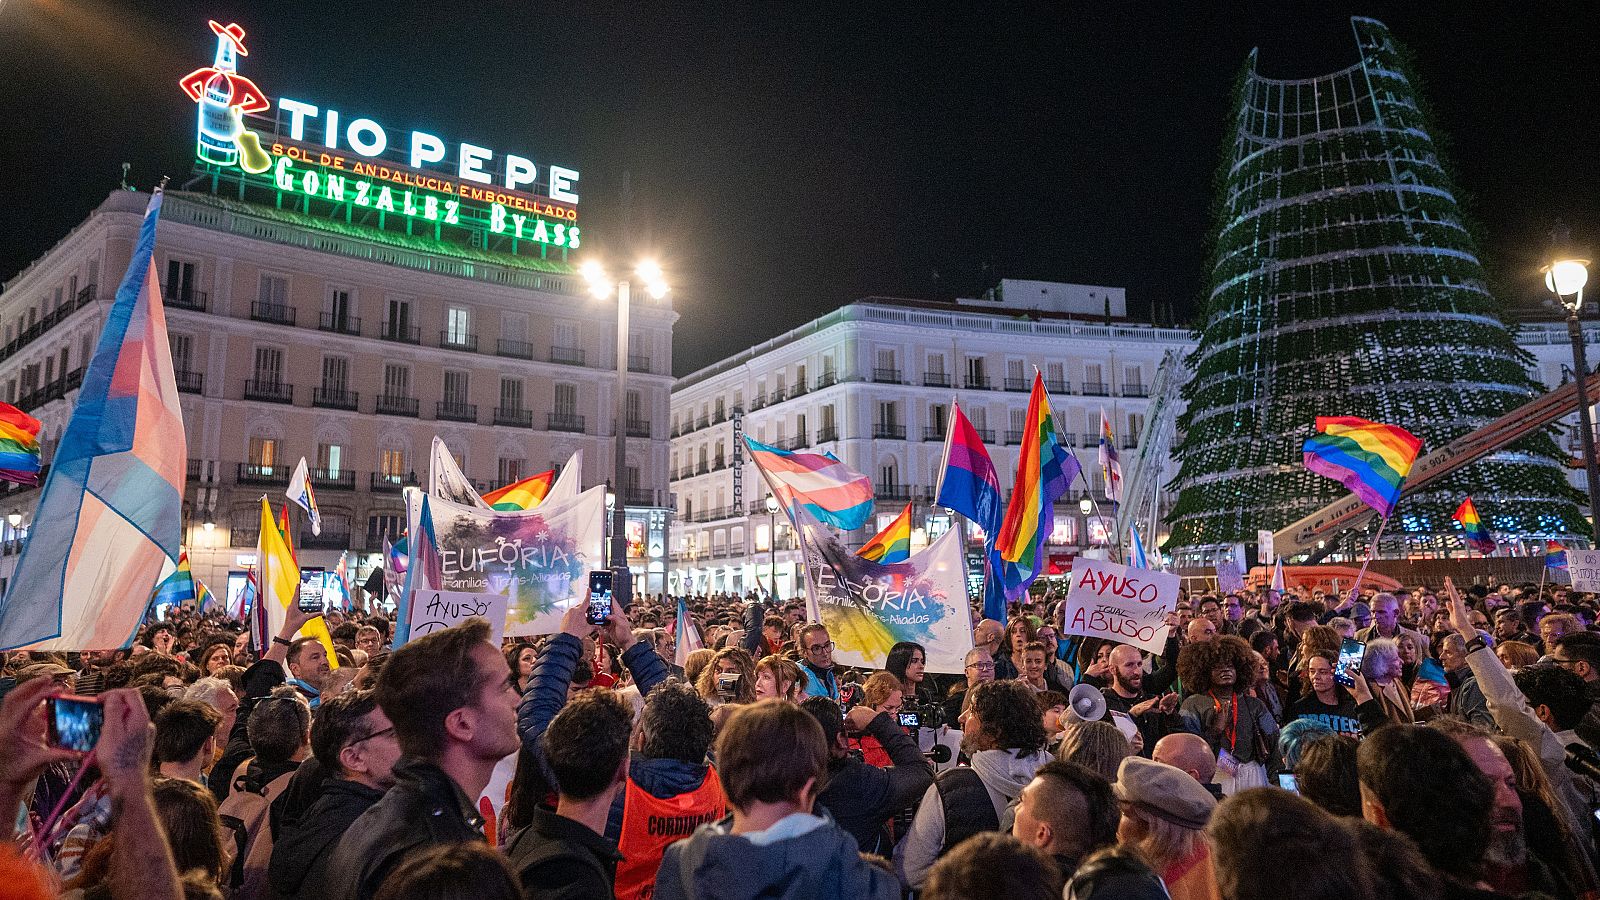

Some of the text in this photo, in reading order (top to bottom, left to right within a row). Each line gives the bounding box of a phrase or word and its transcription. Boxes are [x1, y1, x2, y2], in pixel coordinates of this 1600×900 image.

[278, 97, 580, 205] TIO PEPE
[271, 142, 578, 221] SOL DE ANDALUCIA EMBOTELLADO
[734, 460, 743, 513] EUROPA
[442, 574, 489, 590] Familias
[1078, 567, 1158, 604] AYUSO
[426, 593, 491, 619] AYUSO
[1070, 606, 1155, 642] ABUSO
[1096, 604, 1133, 618] IGUAL
